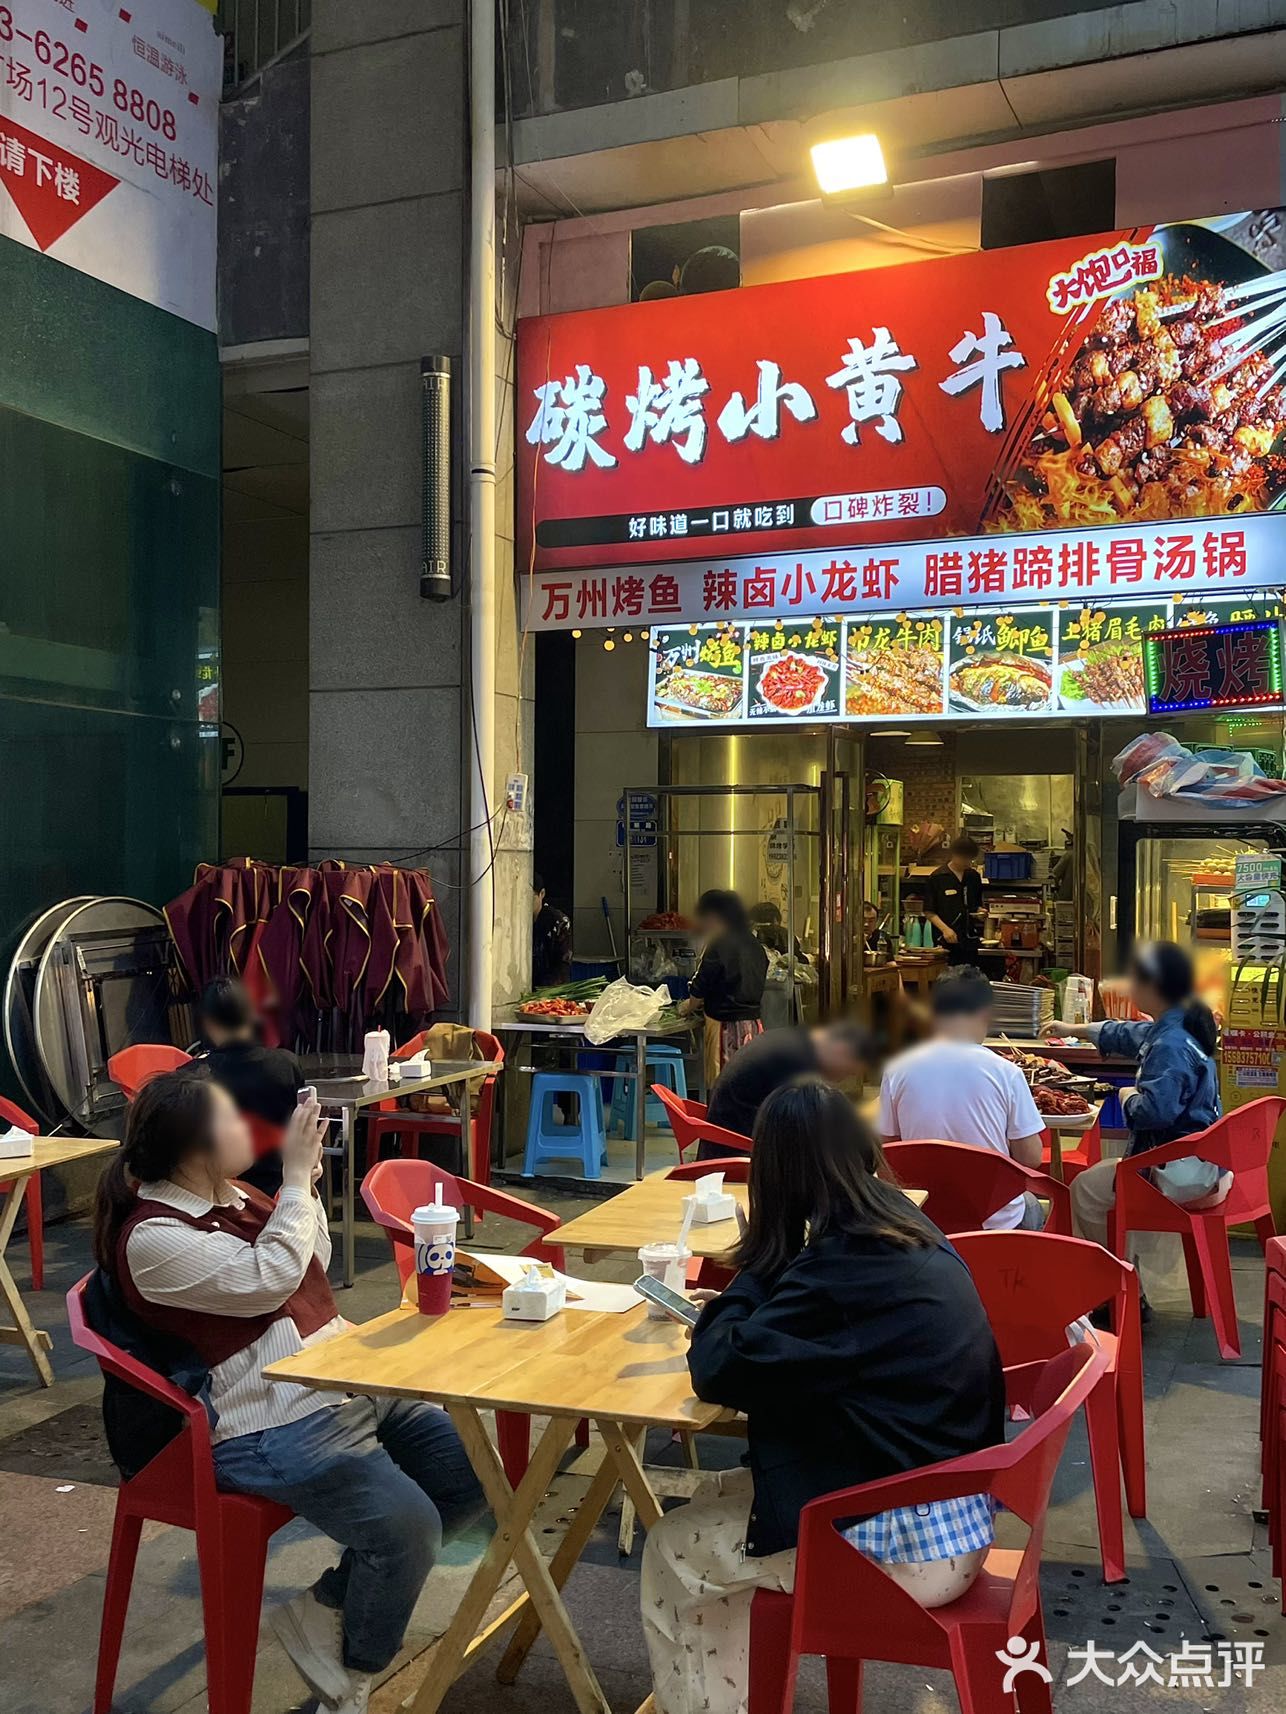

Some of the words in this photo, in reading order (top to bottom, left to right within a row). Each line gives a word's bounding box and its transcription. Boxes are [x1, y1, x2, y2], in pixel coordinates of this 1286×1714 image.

[132, 34, 188, 85] 恒温游泳
[0, 55, 214, 207] 场12号观光电梯处
[113, 78, 177, 141] 8808
[0, 131, 80, 206] 请下楼
[1052, 247, 1159, 308] 大饱口福
[525, 311, 1027, 471] 碳烤小黄牛
[628, 503, 796, 538] 好味道一口就吃到
[541, 573, 683, 621] 万州烤鱼
[703, 558, 901, 611] 辣卤小龙虾
[924, 531, 1248, 596] 腊猪蹄排骨汤锅
[1159, 631, 1270, 702] 烧烤
